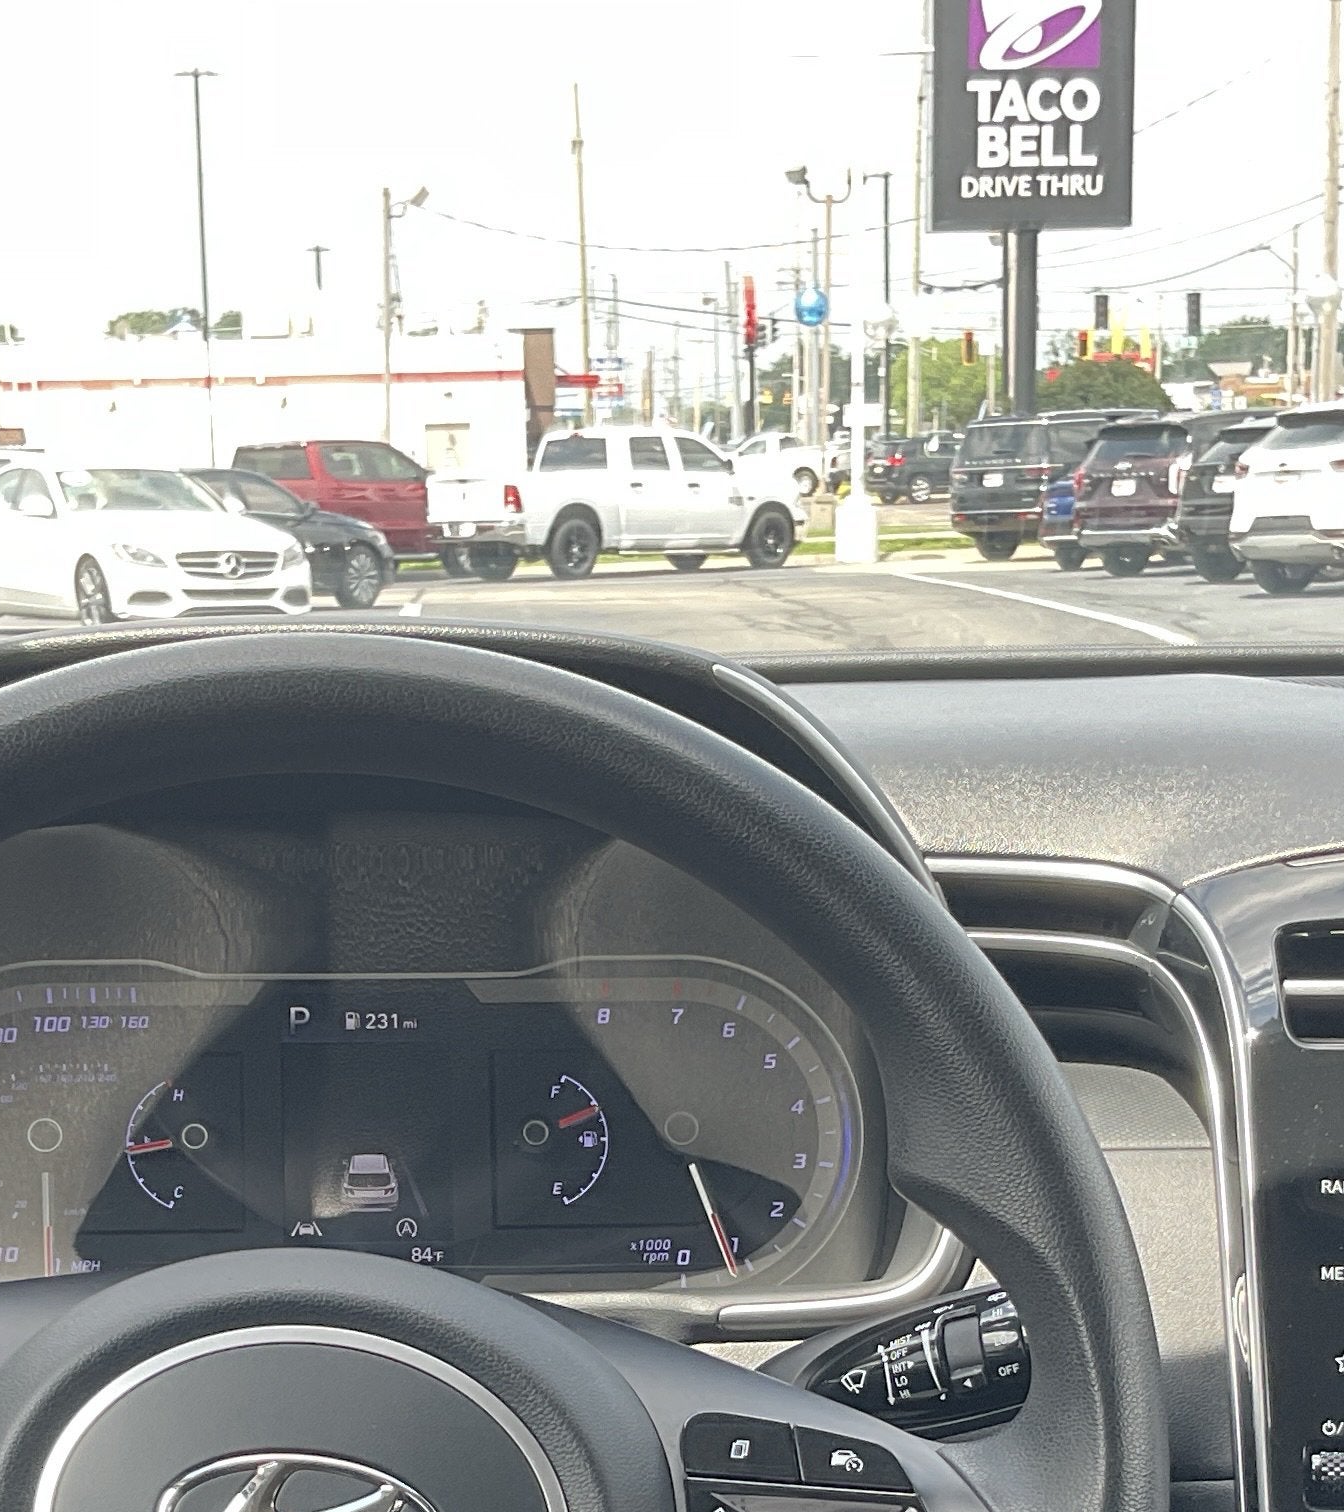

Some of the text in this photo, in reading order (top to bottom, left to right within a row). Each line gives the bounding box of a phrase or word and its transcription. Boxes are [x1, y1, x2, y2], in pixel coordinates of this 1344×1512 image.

[966, 77, 1101, 123] TACO
[976, 123, 1098, 169] BELL
[960, 174, 1104, 199] DRIVE THRU
[32, 1015, 71, 1034] 100
[119, 1015, 150, 1030] 160
[289, 1007, 311, 1034] P
[365, 1012, 418, 1031] 231 mi
[597, 1008, 611, 1025] 8
[671, 1008, 684, 1025] 7
[722, 1022, 736, 1039] 6
[763, 1053, 777, 1069] 5
[173, 1089, 185, 1102] H
[550, 1085, 562, 1099] F
[790, 1099, 805, 1115] 4
[792, 1153, 807, 1169] 3
[174, 1184, 185, 1199] C
[552, 1182, 563, 1195] E
[769, 1201, 785, 1218] 2
[642, 1251, 670, 1265] rpm
[677, 1249, 691, 1266] 0
[71, 1259, 102, 1273] MPH
[890, 1347, 908, 1361] OFF
[998, 1363, 1019, 1376] OFF
[895, 1375, 908, 1388] LO
